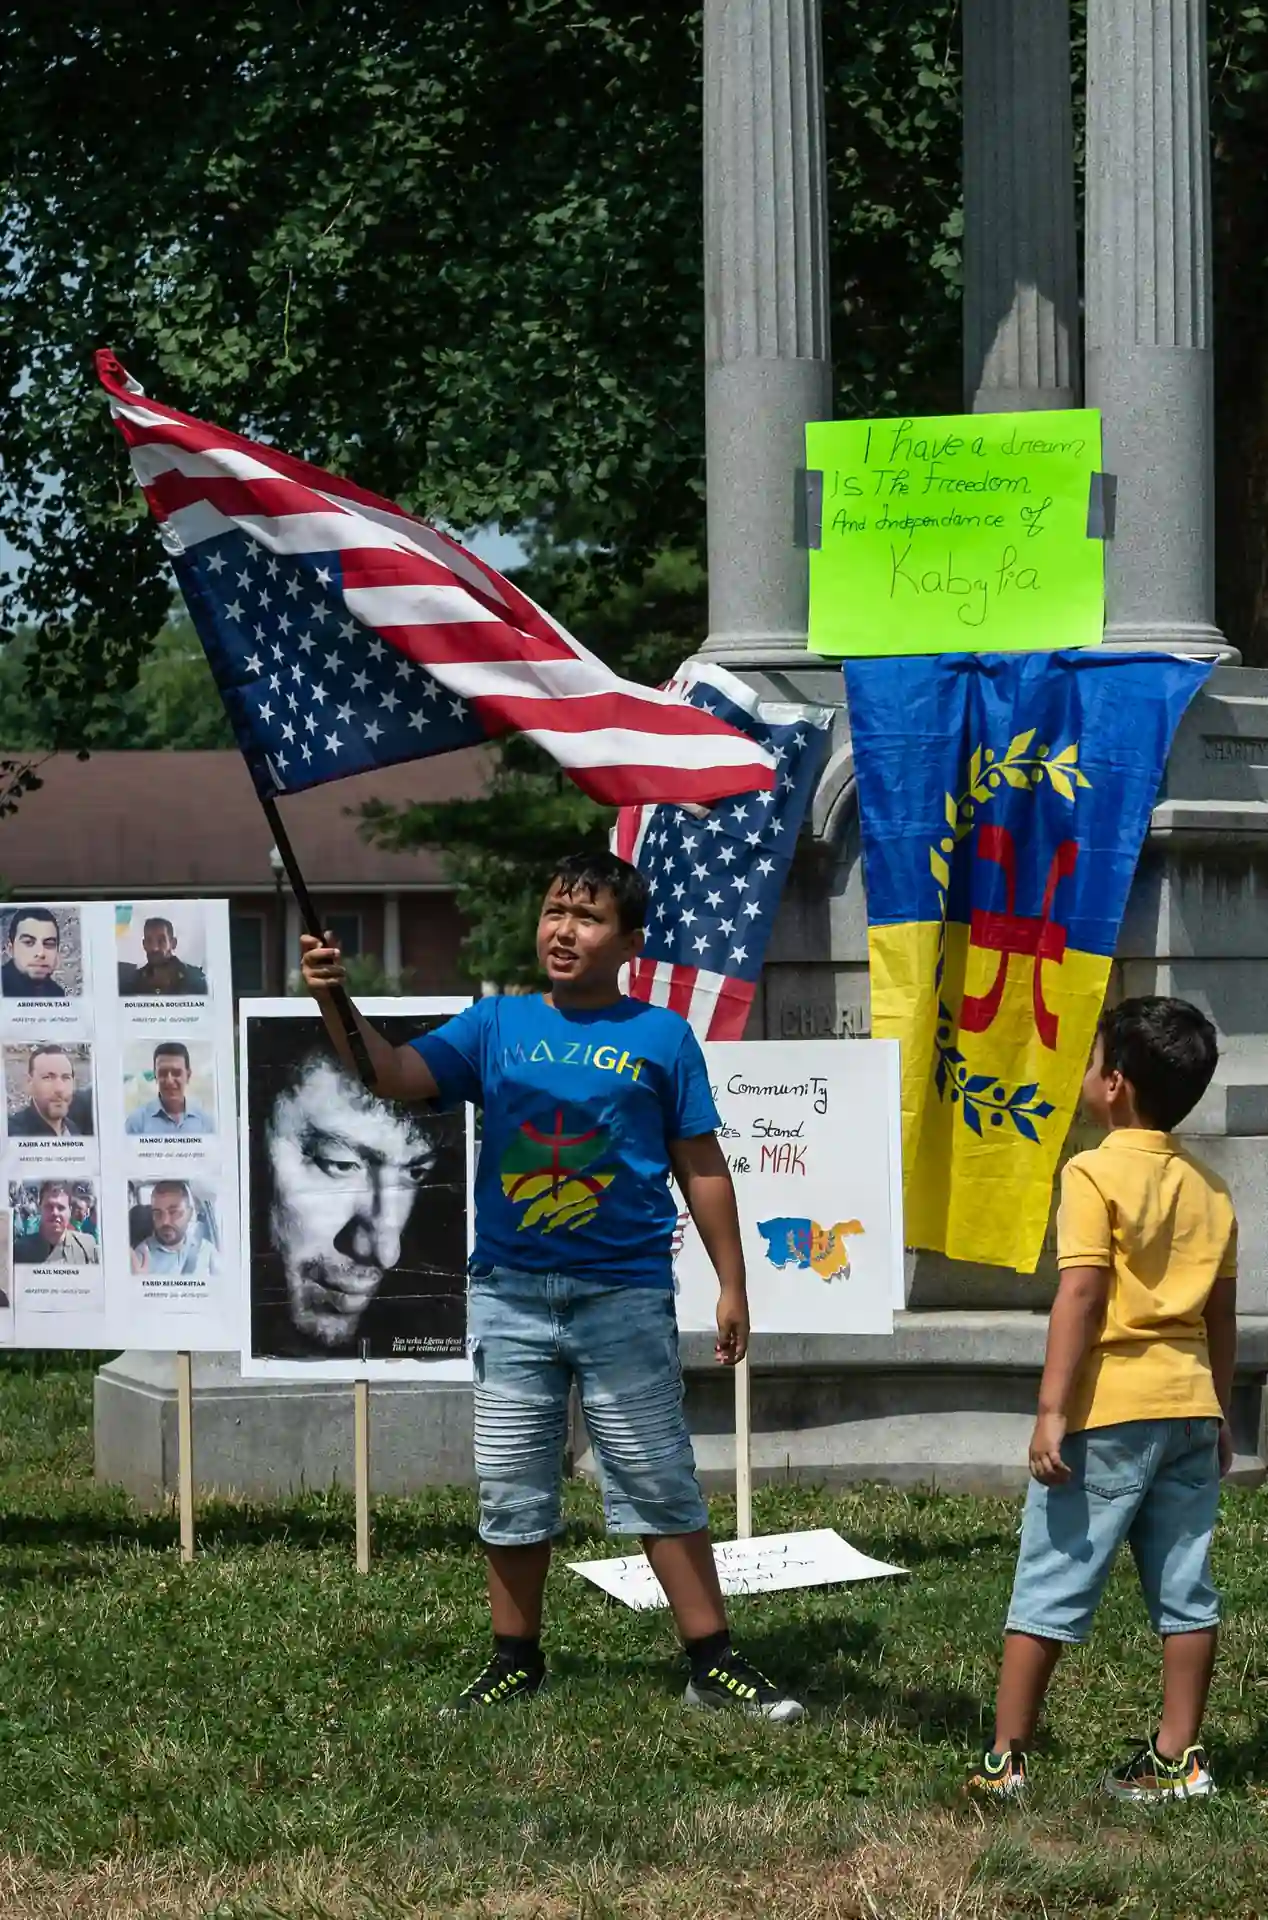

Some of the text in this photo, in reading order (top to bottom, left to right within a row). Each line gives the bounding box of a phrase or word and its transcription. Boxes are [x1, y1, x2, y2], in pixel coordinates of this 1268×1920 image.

[862, 419, 1085, 464] I have a dream
[921, 461, 1032, 495] Freedom
[831, 508, 866, 536] And
[1019, 496, 1053, 537] of
[889, 543, 1041, 626] Kabylia
[751, 1118, 805, 1139] Stand
[732, 1156, 751, 1174] the
[760, 1143, 809, 1176] MAK
